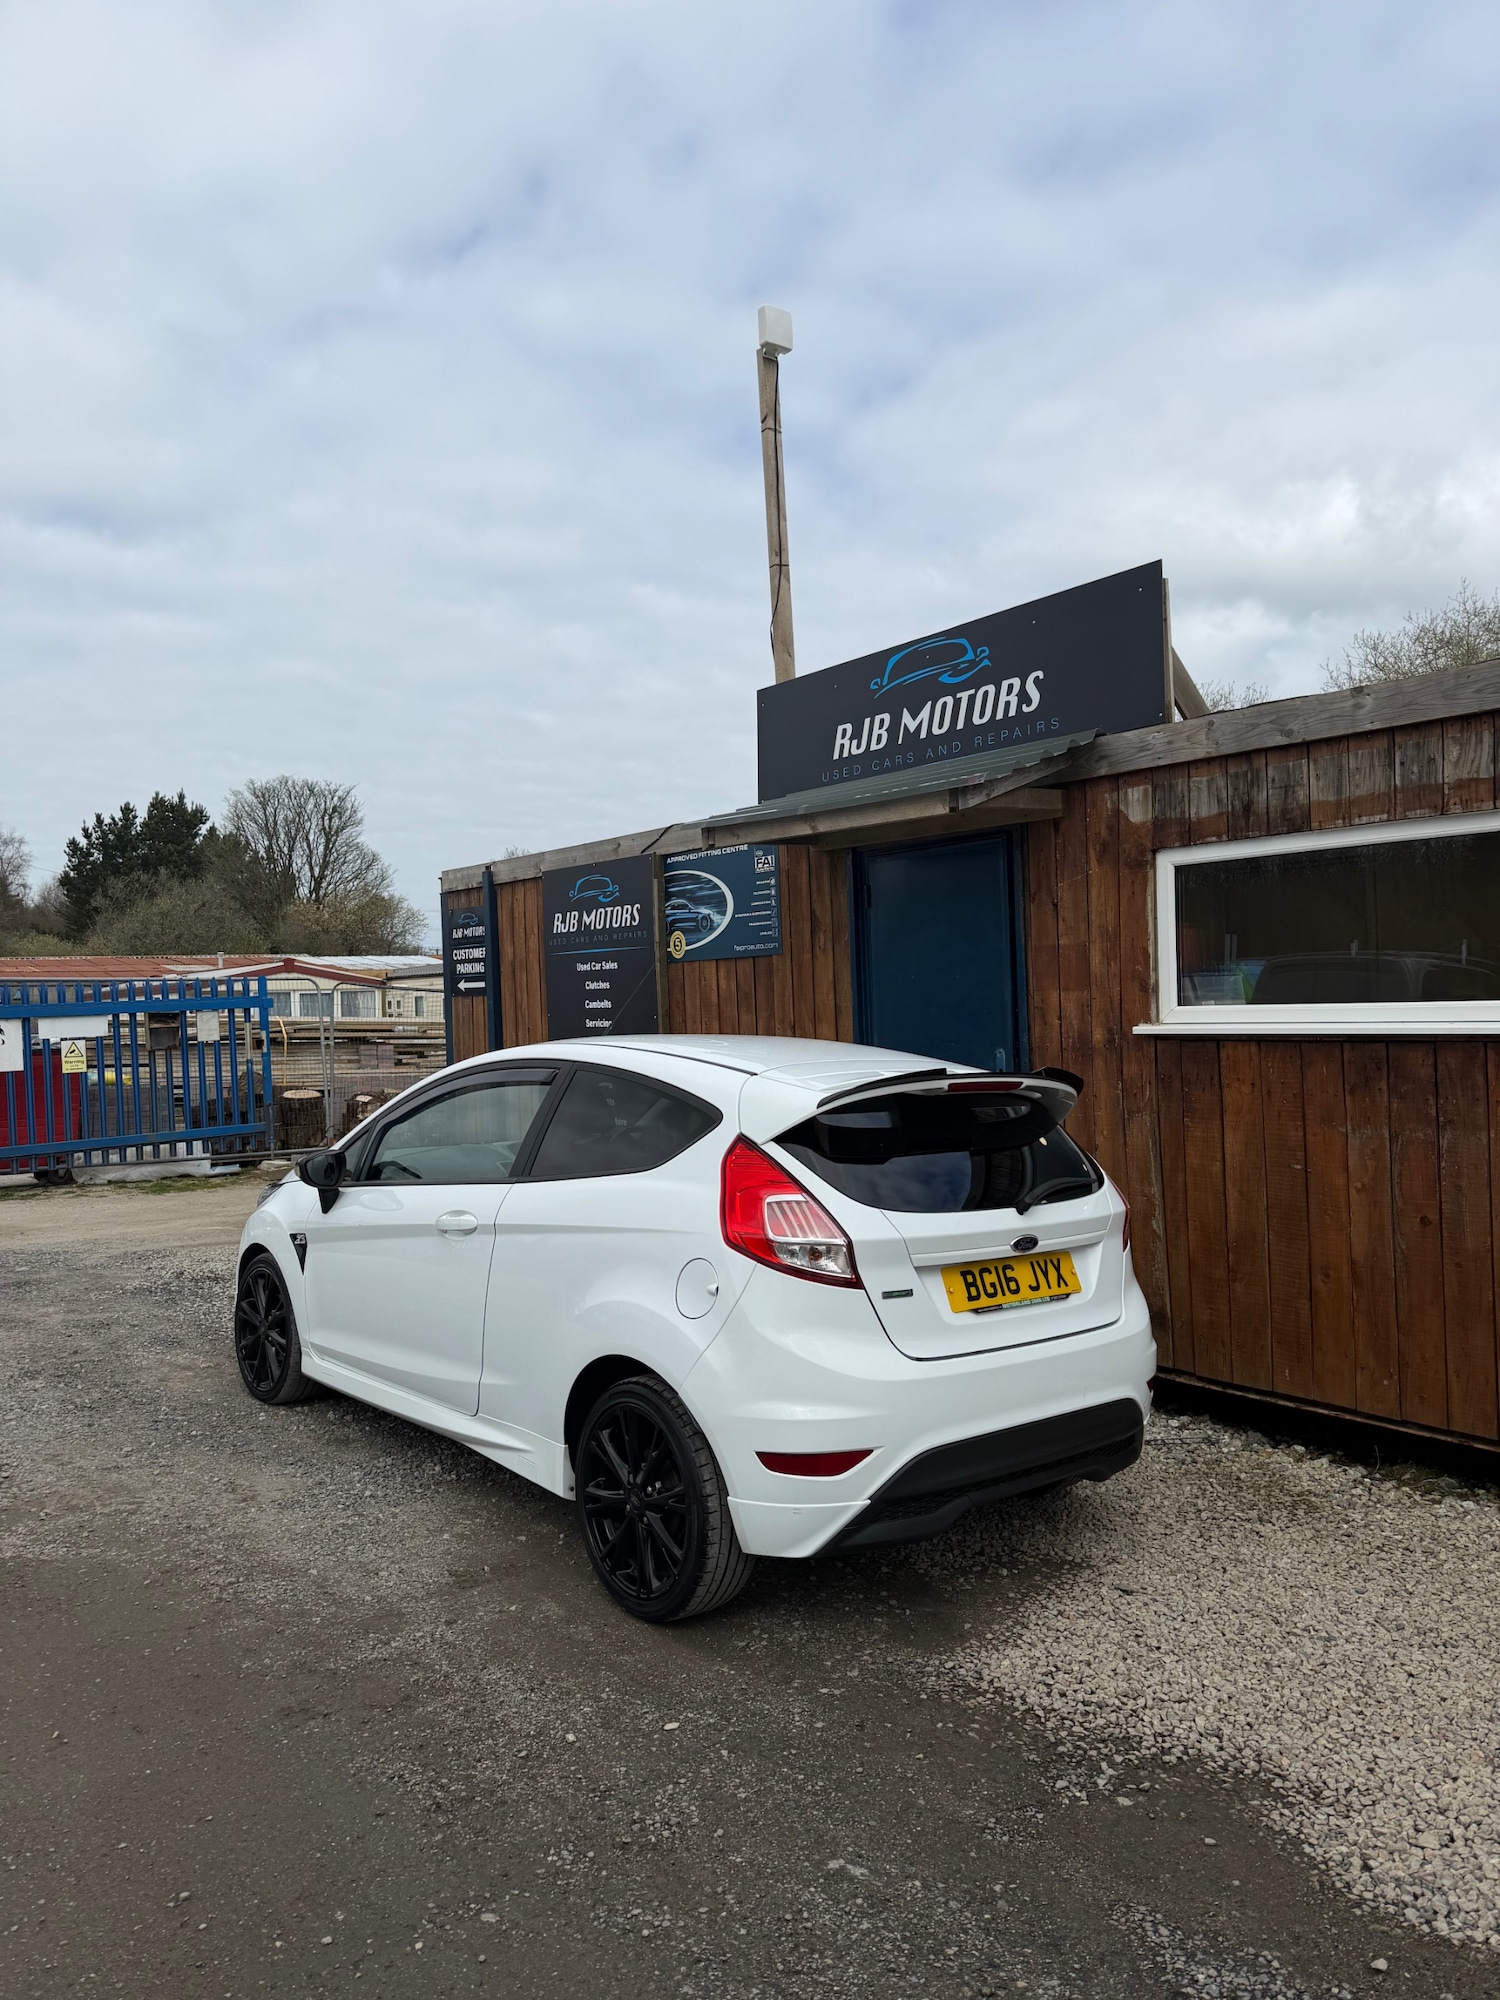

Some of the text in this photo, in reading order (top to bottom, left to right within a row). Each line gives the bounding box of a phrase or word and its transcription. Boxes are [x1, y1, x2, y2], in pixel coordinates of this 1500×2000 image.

[833, 670, 1044, 760] RJB MOTORS
[822, 717, 1060, 782] USED CARS AND REPAIRS
[666, 852, 698, 864] APPROVED
[698, 848, 721, 859] FITTING
[722, 843, 749, 855] CENTRE
[756, 856, 774, 868] FAI
[553, 903, 640, 933] RJB MOTORS
[549, 930, 648, 946] USED CARS AND REPAIRS
[675, 938, 681, 952] 5
[456, 962, 485, 974] PARKING
[576, 960, 618, 971] Used Car Sales
[585, 980, 611, 990] Clutches
[584, 999, 612, 1009] Cambelts
[960, 1257, 1069, 1302] BG16 JYX
